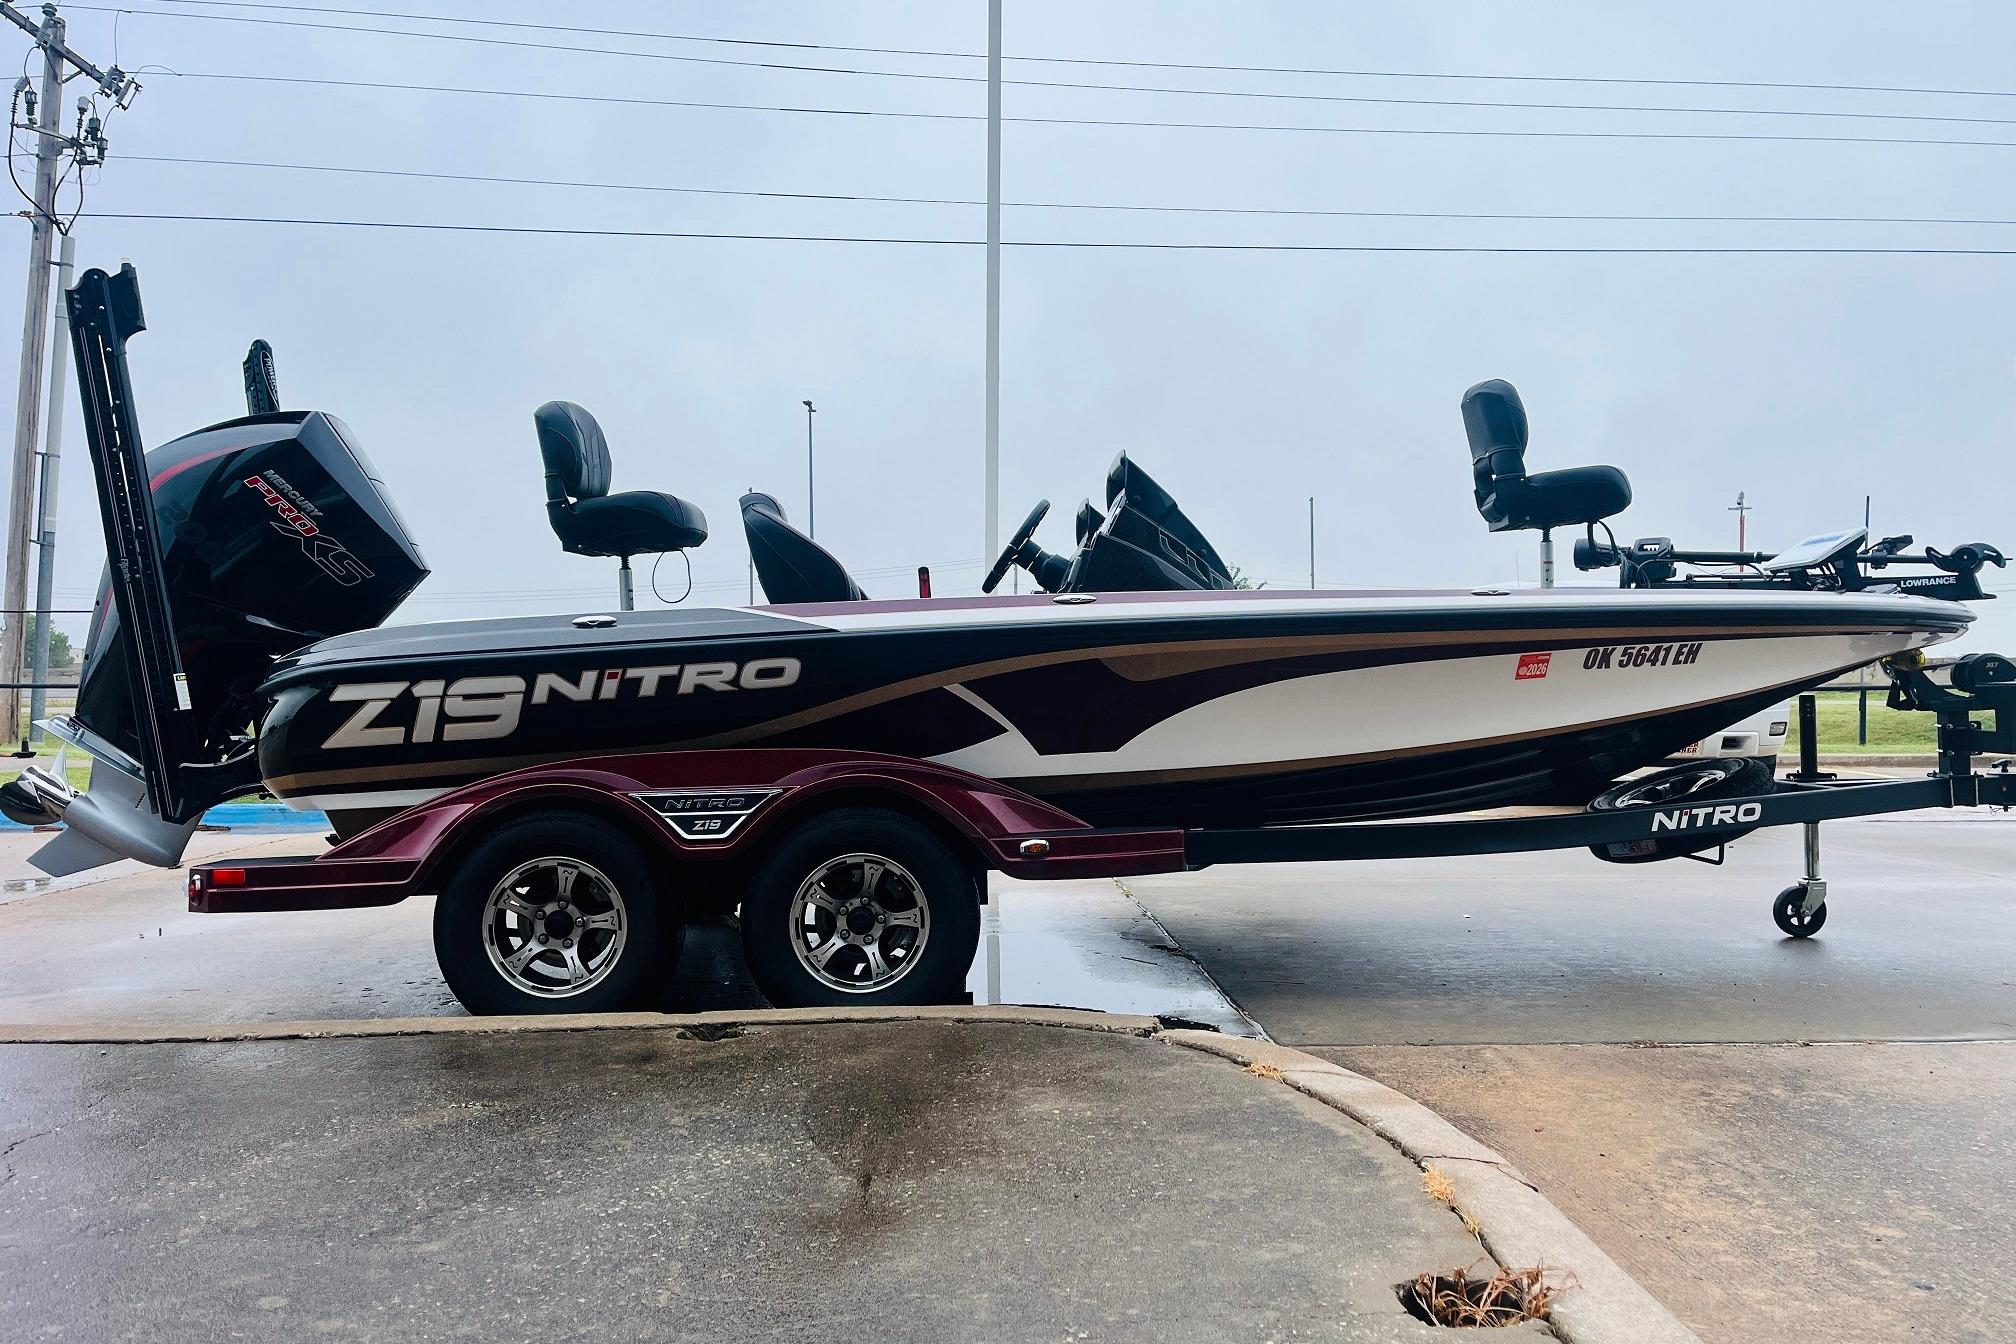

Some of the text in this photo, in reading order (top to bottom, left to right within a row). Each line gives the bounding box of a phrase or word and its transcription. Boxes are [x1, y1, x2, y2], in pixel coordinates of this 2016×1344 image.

[243, 475, 319, 536] PRO
[263, 469, 324, 517] MERCURY
[269, 511, 375, 586] XS
[1900, 576, 1957, 588] LOWRANCE
[1526, 663, 1548, 675] 2026
[1582, 642, 1704, 670] OK 5641 EH
[320, 675, 528, 749] Z19
[692, 819, 722, 831] Z19
